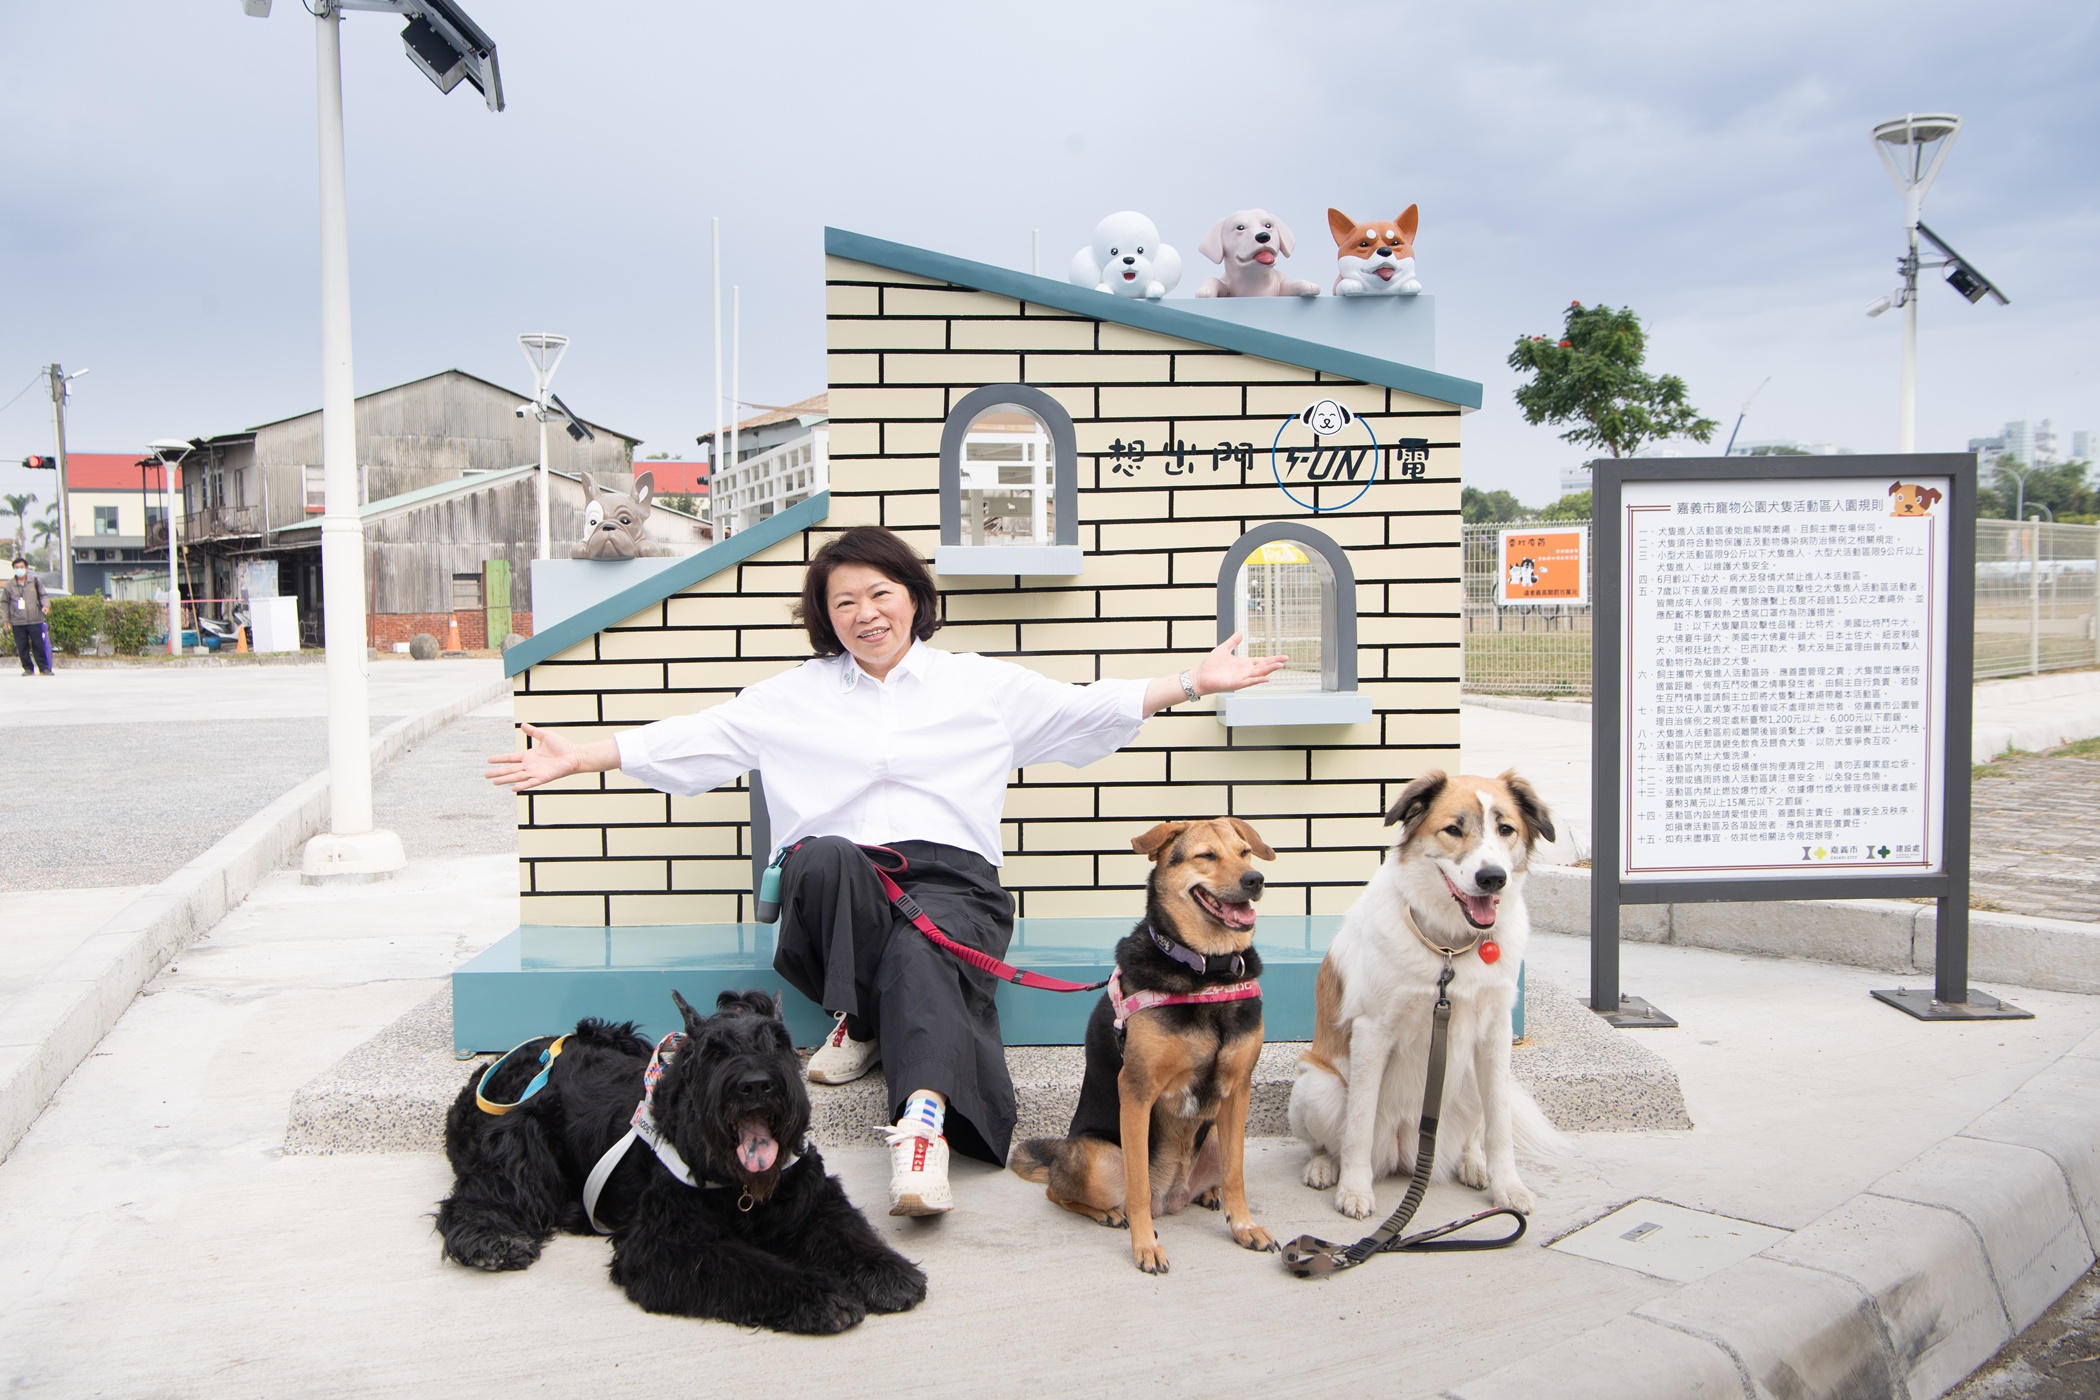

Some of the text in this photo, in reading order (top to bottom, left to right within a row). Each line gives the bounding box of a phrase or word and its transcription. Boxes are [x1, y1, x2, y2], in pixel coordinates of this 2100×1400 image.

[1108, 438, 1430, 480] 想出門 FUN 電
[1676, 499, 1884, 515] 嘉義市寵物公園犬隻活動區入園規則
[1830, 846, 1858, 854] 嘉義市
[1896, 845, 1920, 853] 建設處
[1188, 981, 1252, 996] ZYDOG
